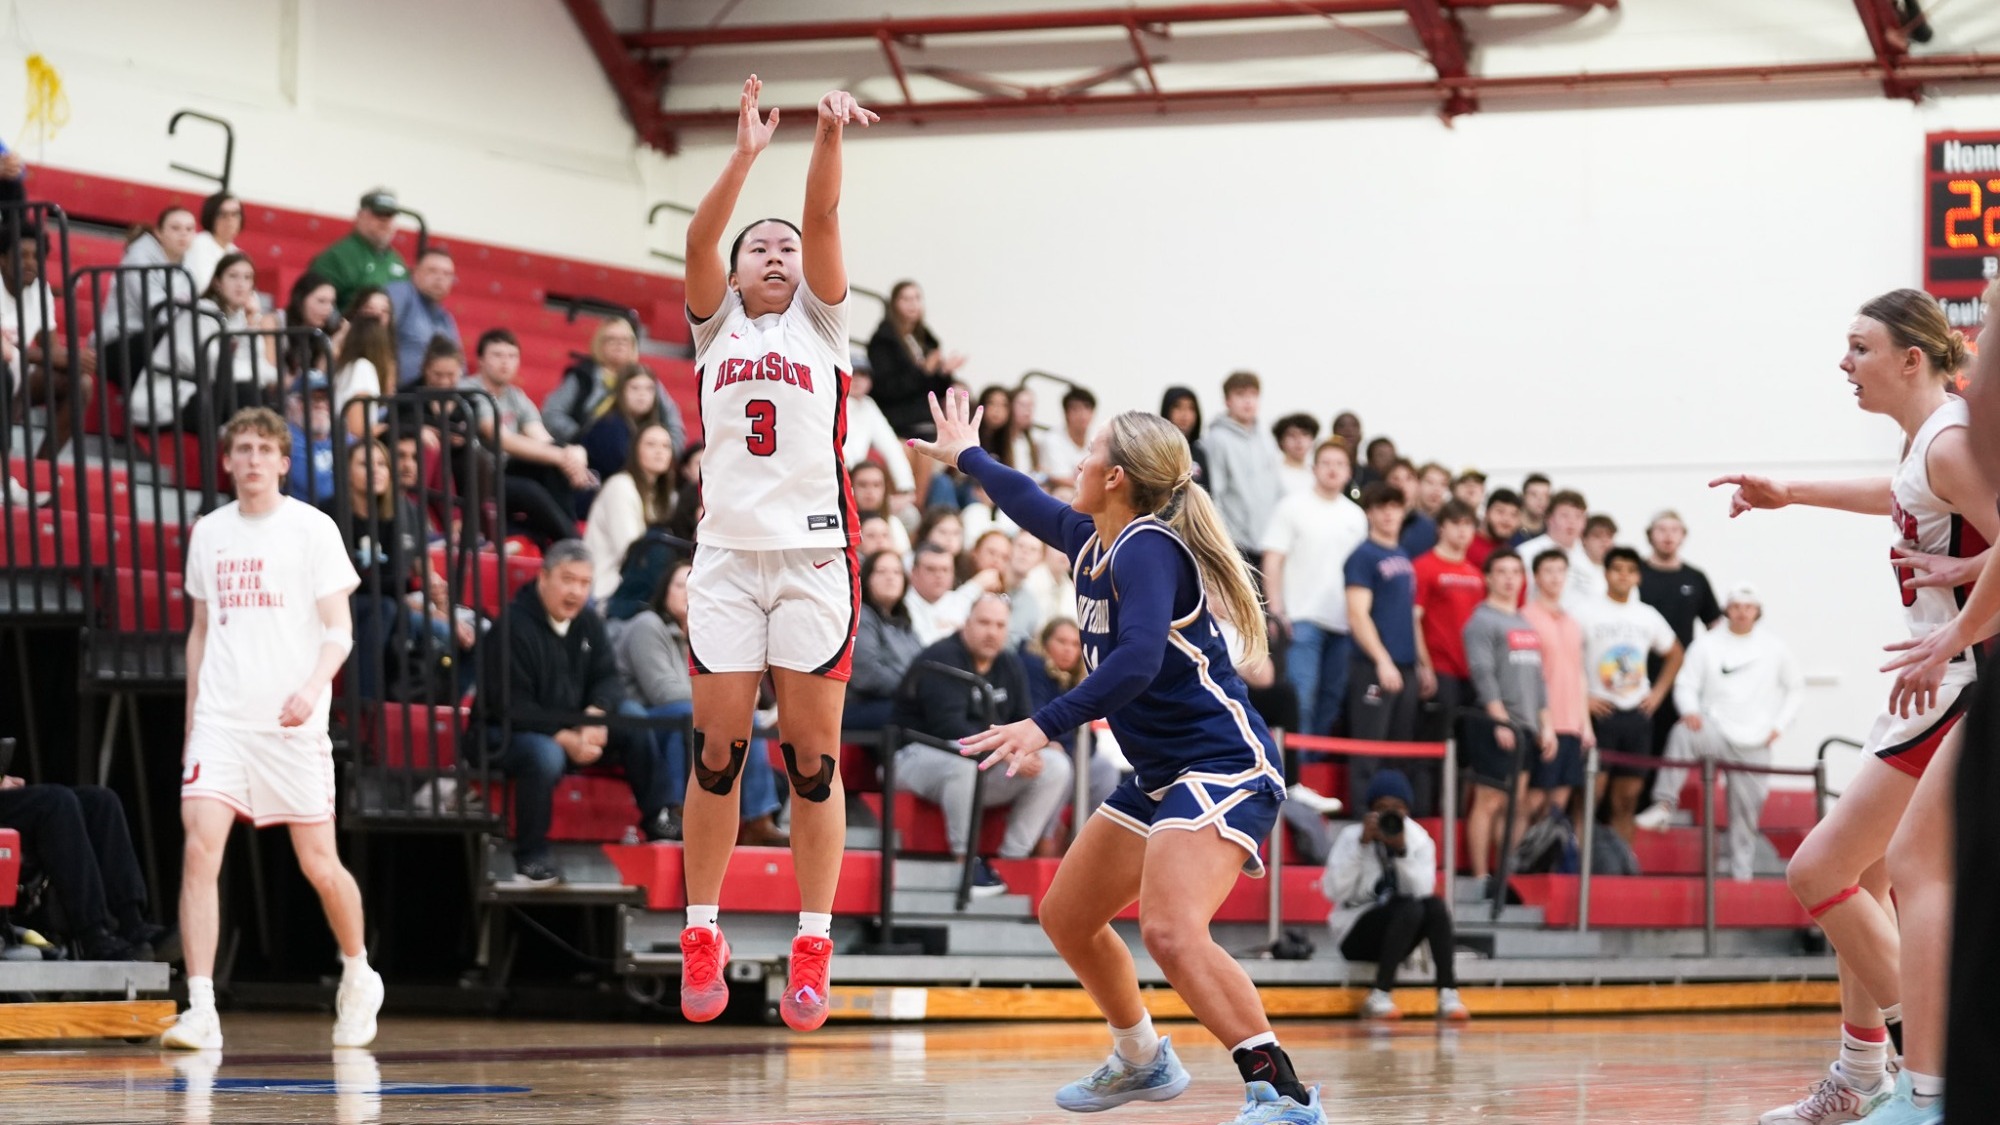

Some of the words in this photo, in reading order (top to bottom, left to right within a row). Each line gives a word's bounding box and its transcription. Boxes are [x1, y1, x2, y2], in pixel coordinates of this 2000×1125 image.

[714, 352, 814, 394] DENISON
[745, 399, 776, 456] 3
[217, 558, 263, 574] DENISON
[239, 575, 261, 590] RED
